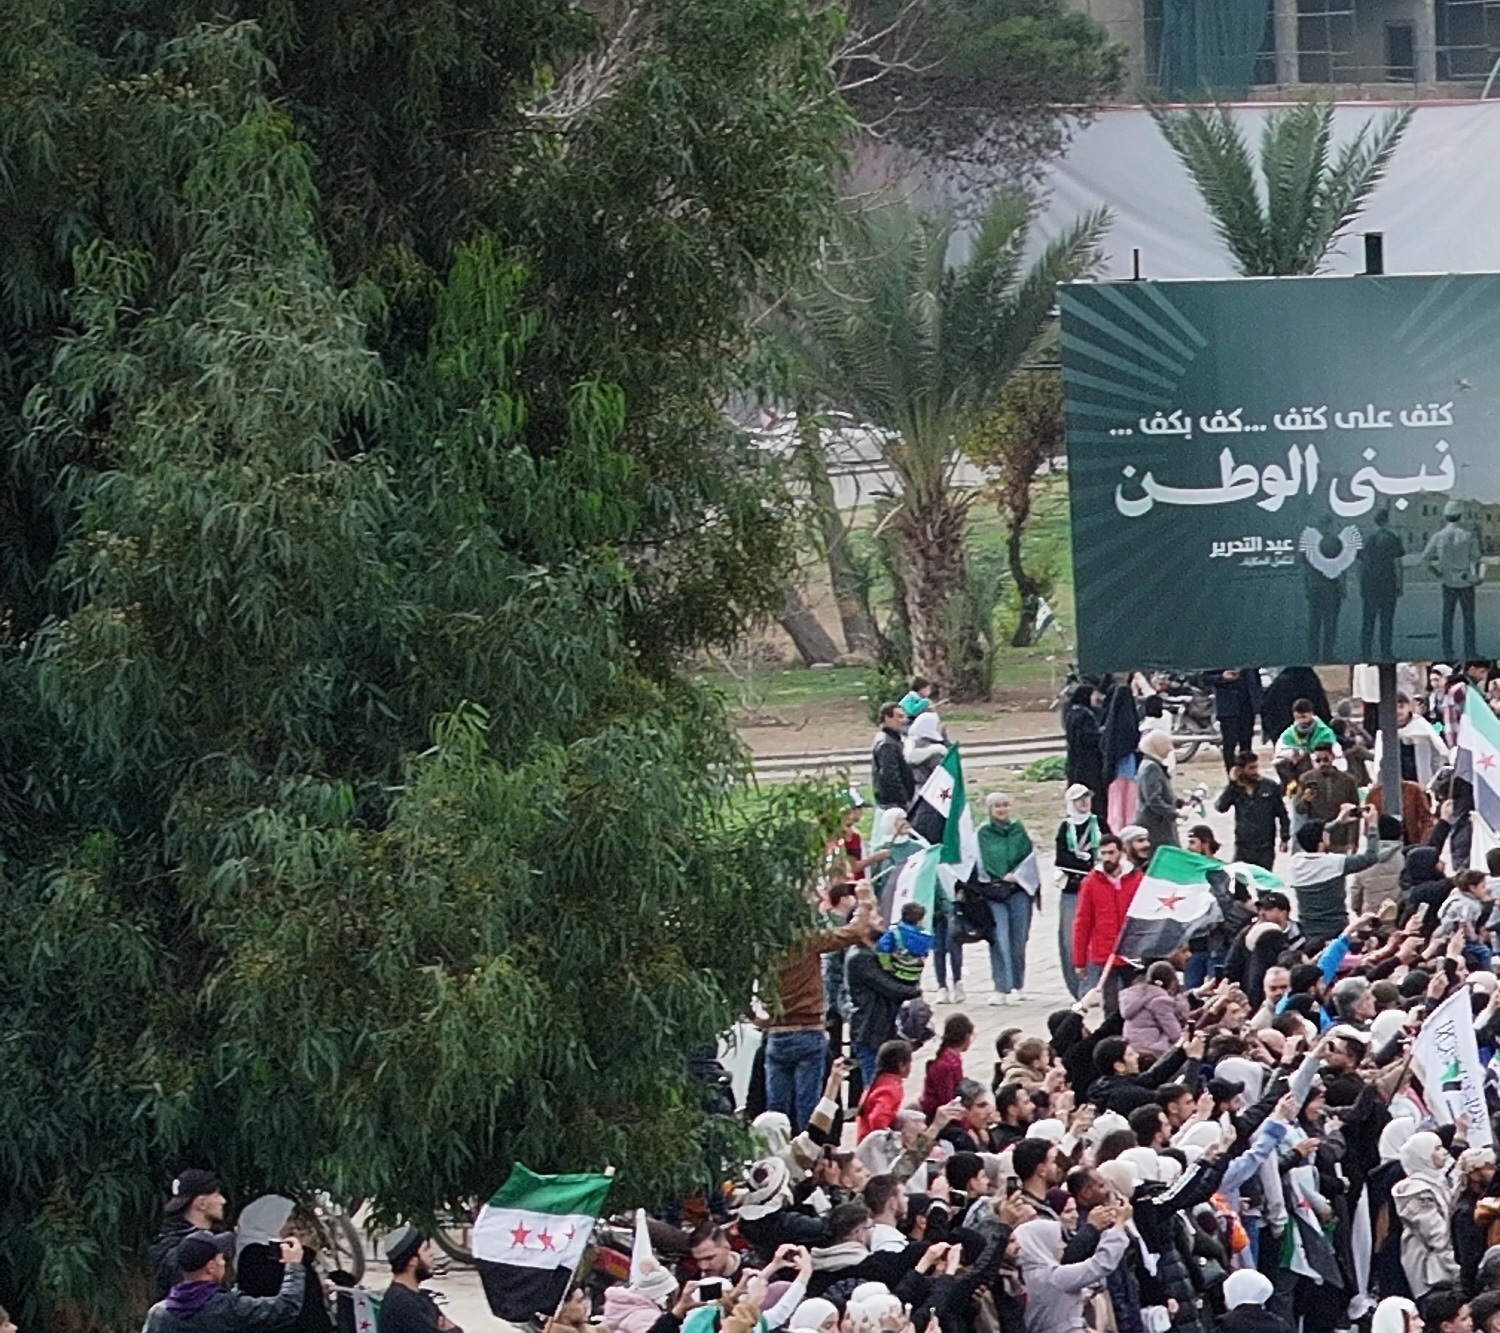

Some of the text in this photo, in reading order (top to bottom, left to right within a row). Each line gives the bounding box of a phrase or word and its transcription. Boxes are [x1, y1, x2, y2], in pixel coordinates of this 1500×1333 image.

[1273, 405, 1328, 430] كتف
[1334, 404, 1394, 429] على
[1400, 401, 1454, 427] كتف
[1114, 444, 1320, 517] الوطن
[1209, 536, 1294, 558] عيد التحرير
